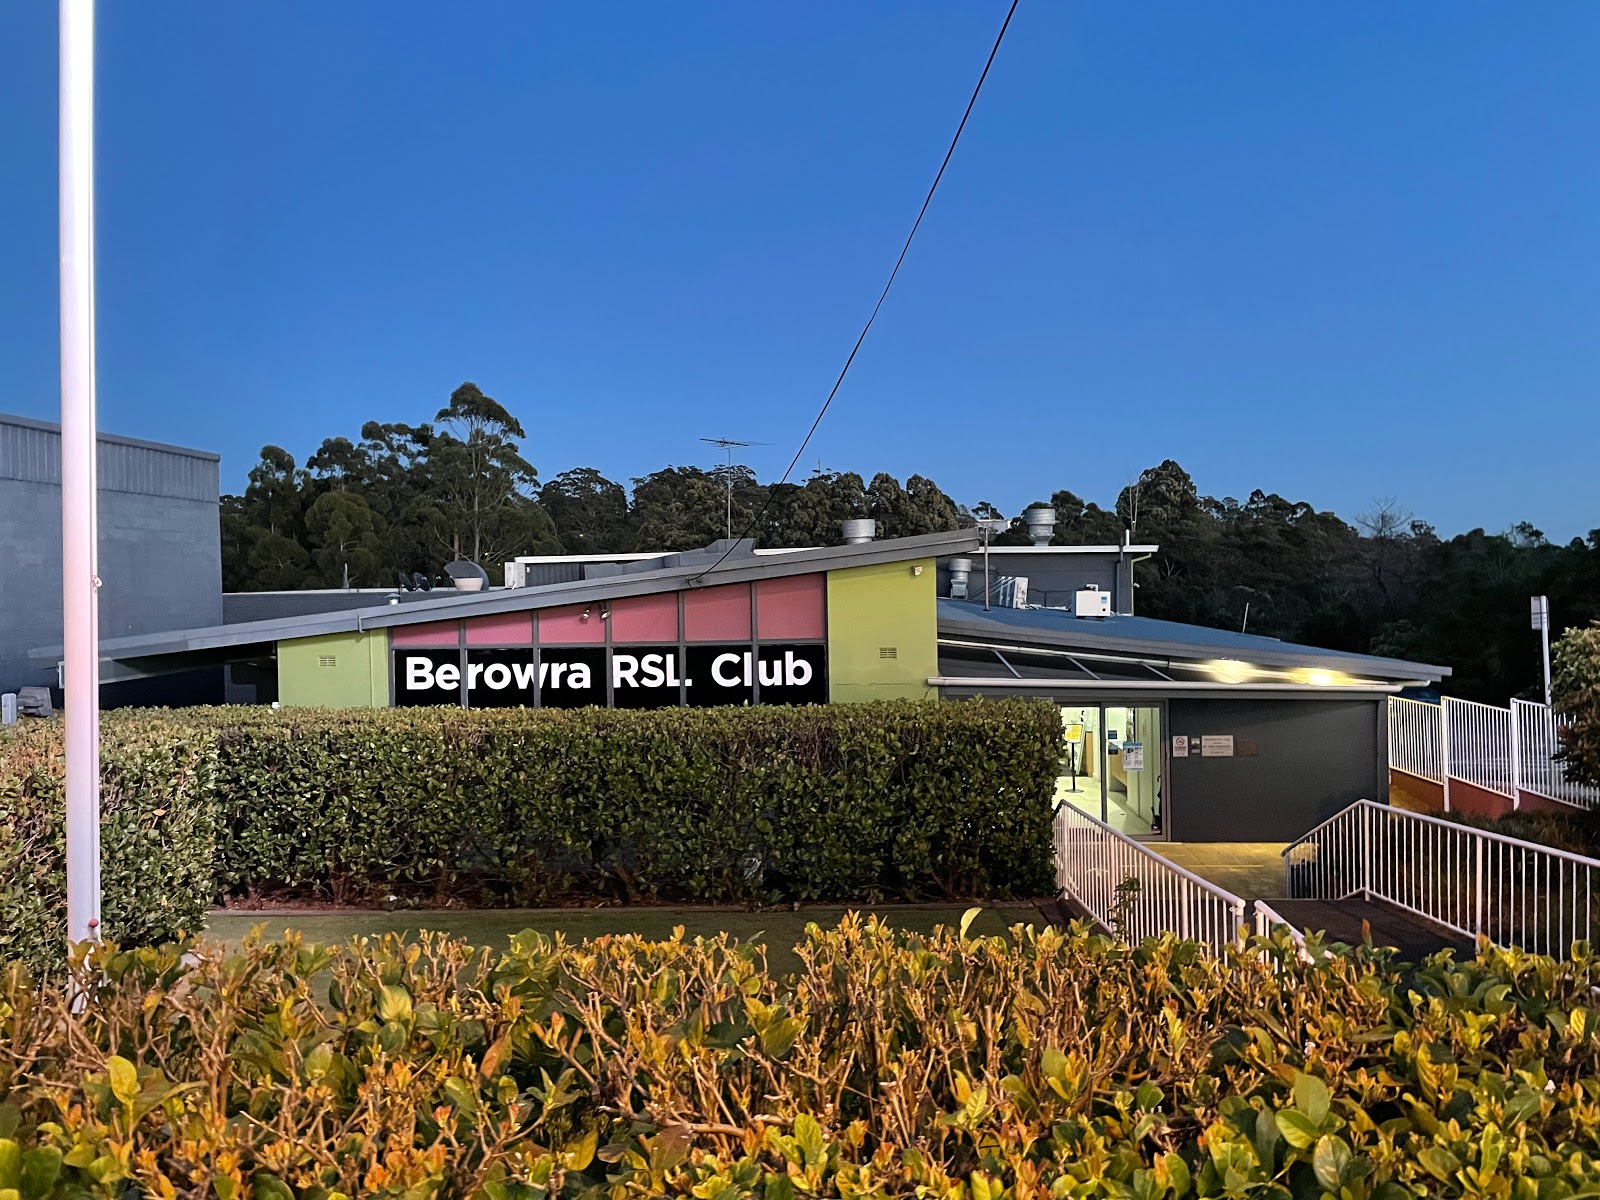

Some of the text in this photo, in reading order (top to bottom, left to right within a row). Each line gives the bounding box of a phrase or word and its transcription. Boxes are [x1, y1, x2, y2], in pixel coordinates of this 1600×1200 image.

[406, 652, 813, 690] Berowra RSL Club
